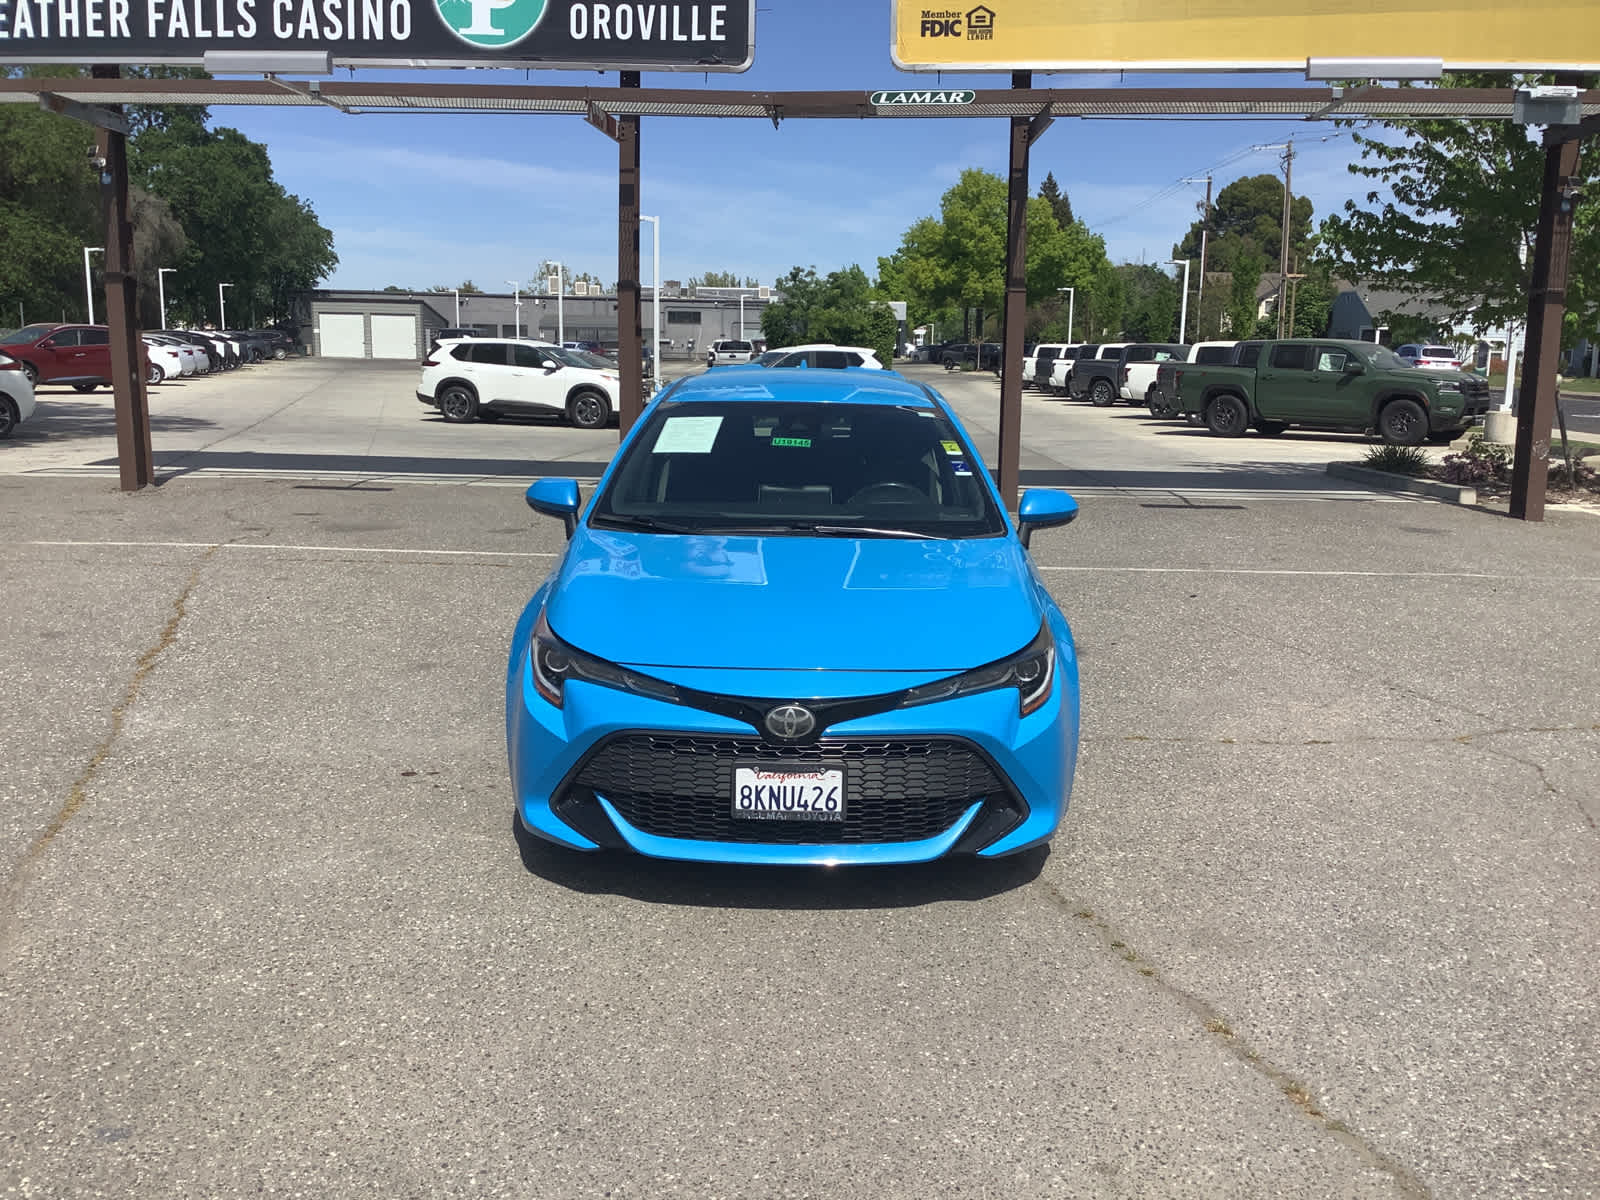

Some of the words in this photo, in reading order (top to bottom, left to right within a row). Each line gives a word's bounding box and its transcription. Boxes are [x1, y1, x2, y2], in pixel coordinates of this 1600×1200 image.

[147, 0, 257, 38] FALLS
[273, 0, 412, 40] CASINO
[569, 3, 727, 41] OROVILLE
[920, 10, 962, 19] Member
[920, 19, 962, 38] FDIC
[879, 92, 965, 104] LAMAR
[740, 785, 839, 811] 8KNU426
